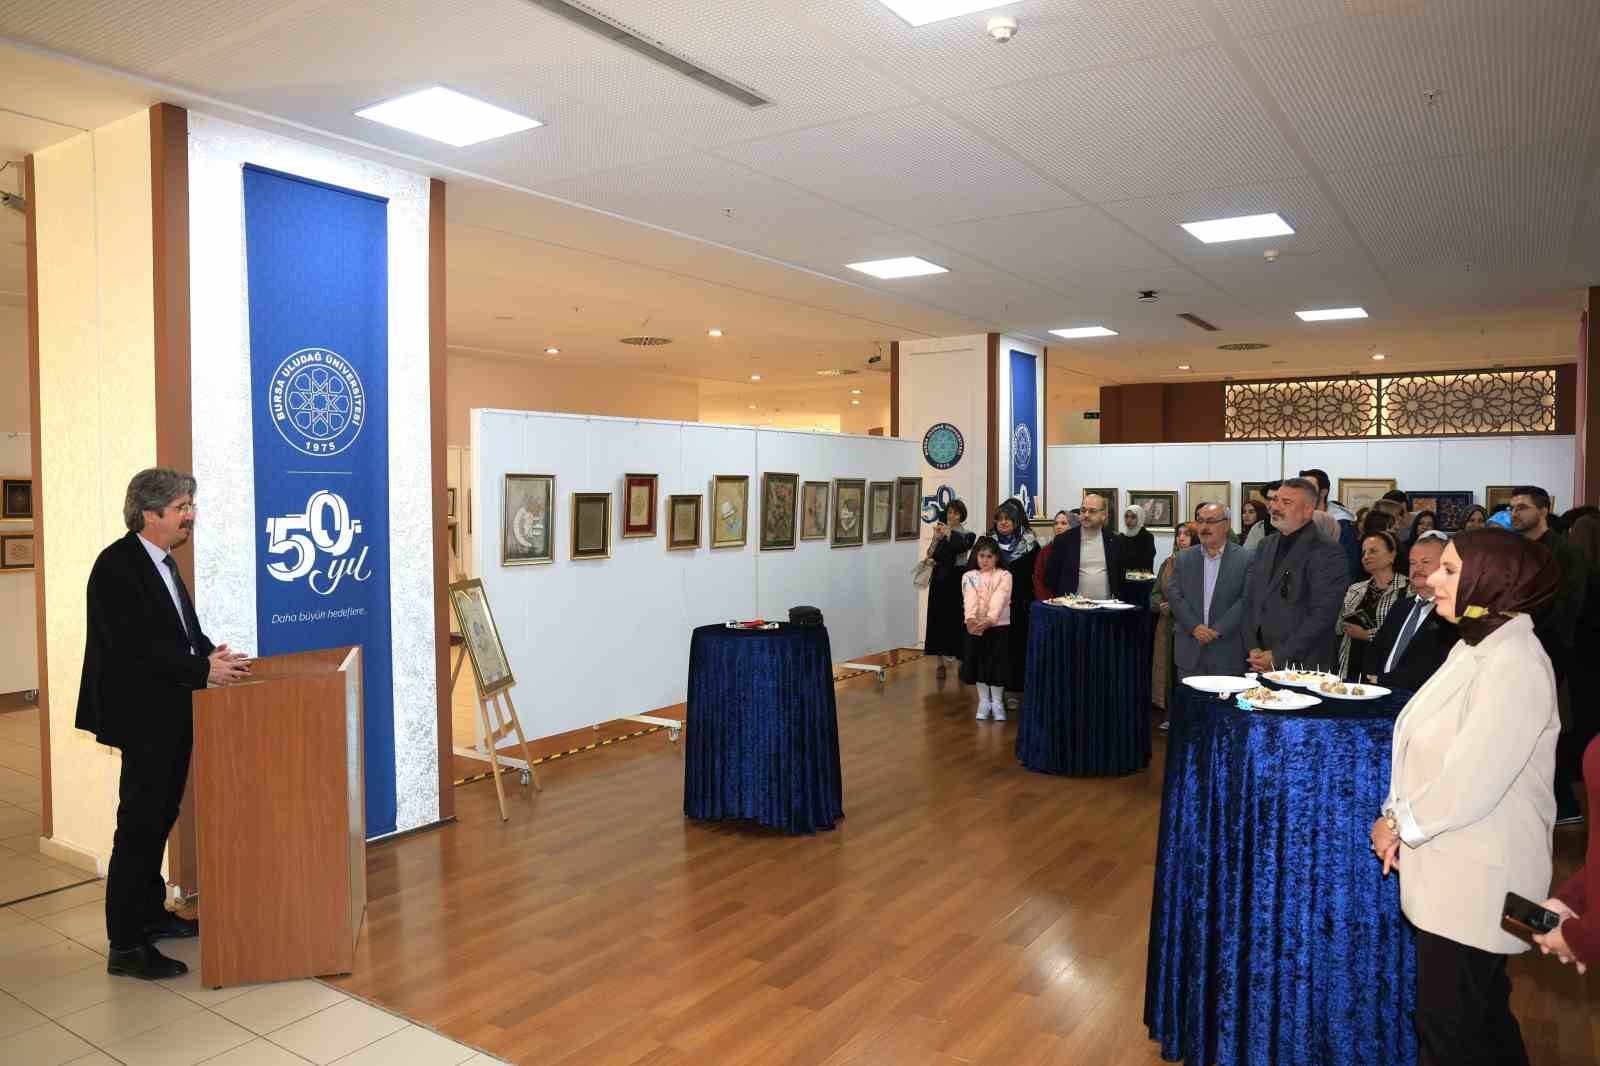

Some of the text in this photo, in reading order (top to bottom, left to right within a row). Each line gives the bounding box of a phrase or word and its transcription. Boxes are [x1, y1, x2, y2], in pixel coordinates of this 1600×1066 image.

[274, 380, 286, 421] BURSA
[281, 352, 322, 378] ULUDAĞ
[305, 442, 336, 452] 1975
[308, 545, 372, 595] yıl
[271, 613, 298, 624] Daha
